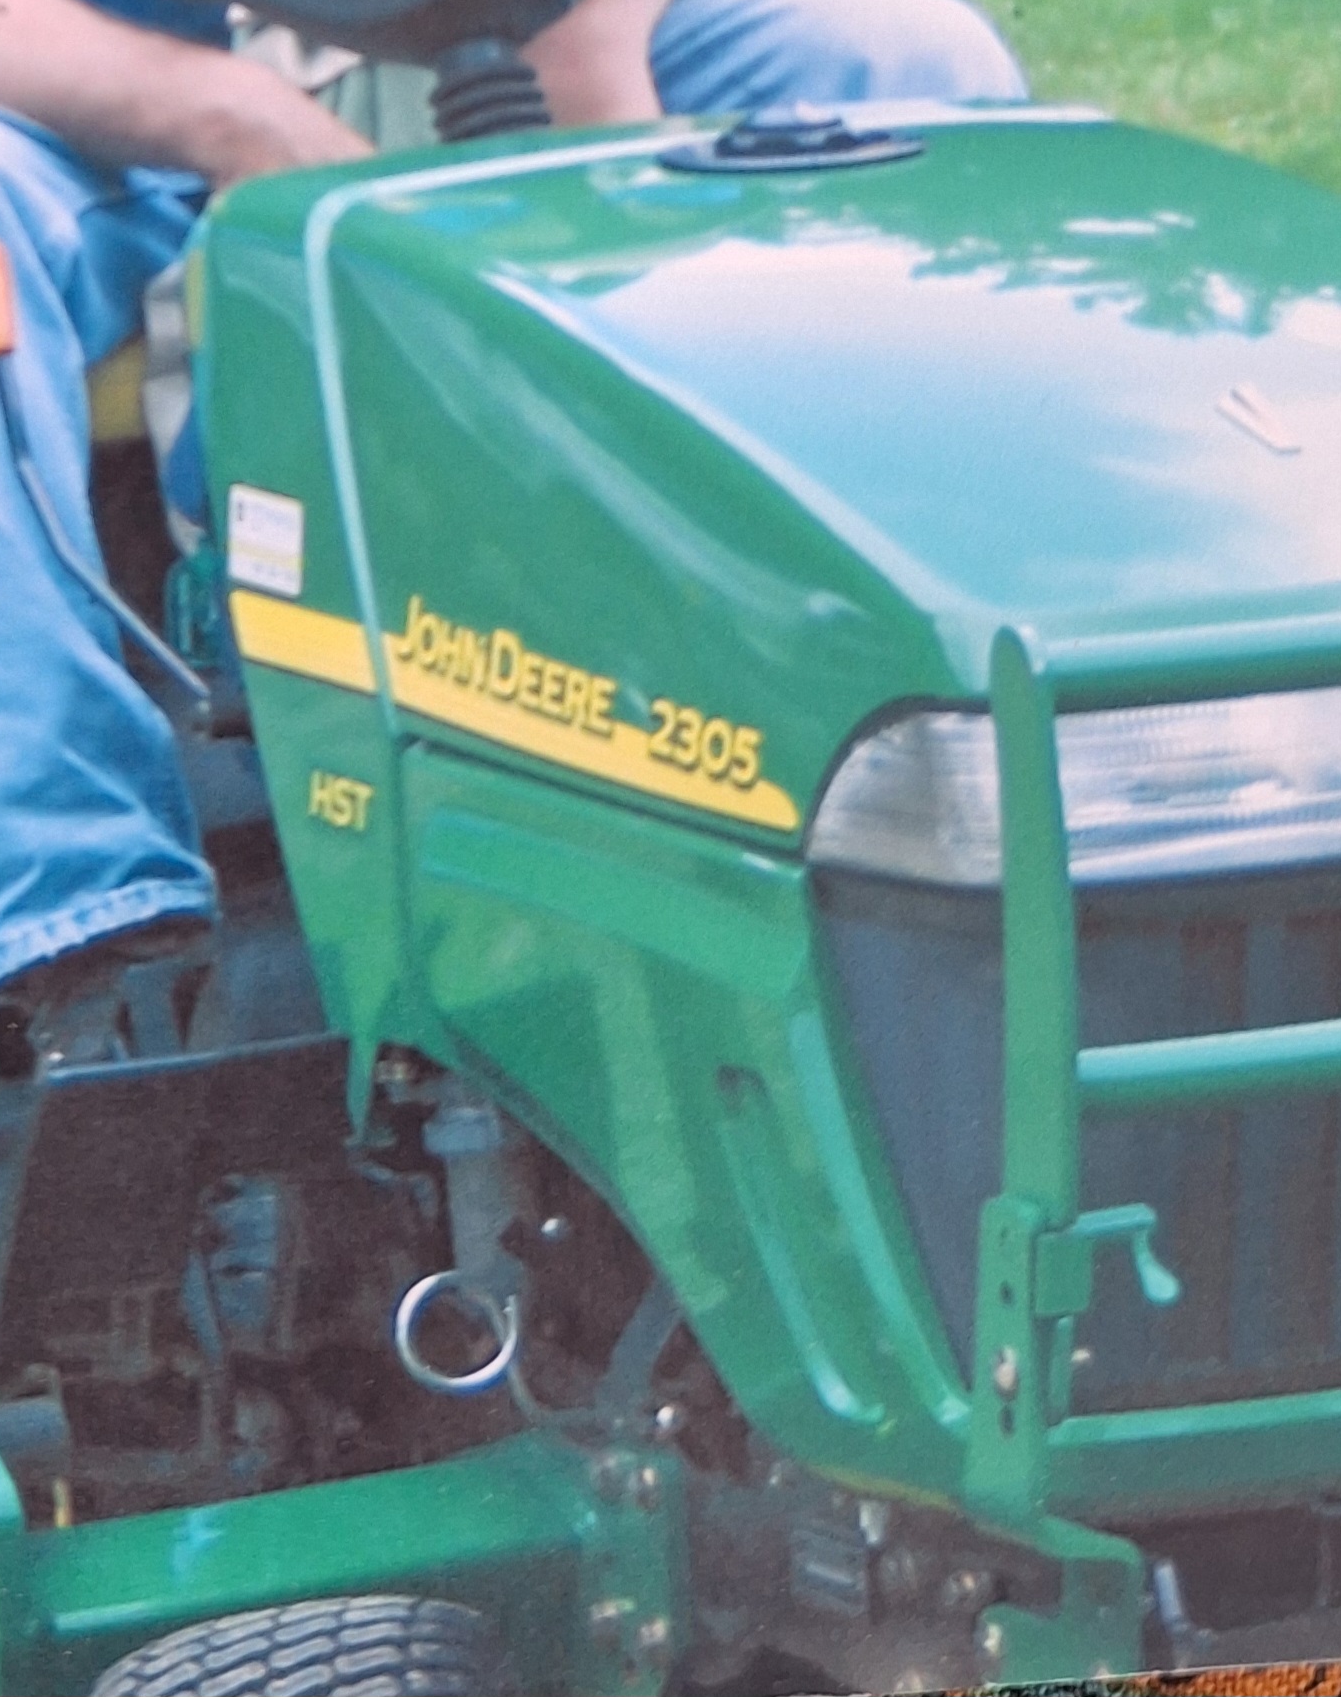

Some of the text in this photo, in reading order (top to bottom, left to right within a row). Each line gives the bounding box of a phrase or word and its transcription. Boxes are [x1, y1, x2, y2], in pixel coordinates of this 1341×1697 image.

[487, 626, 618, 739] DEERE
[647, 698, 762, 789] 2305
[308, 769, 374, 832] HST
